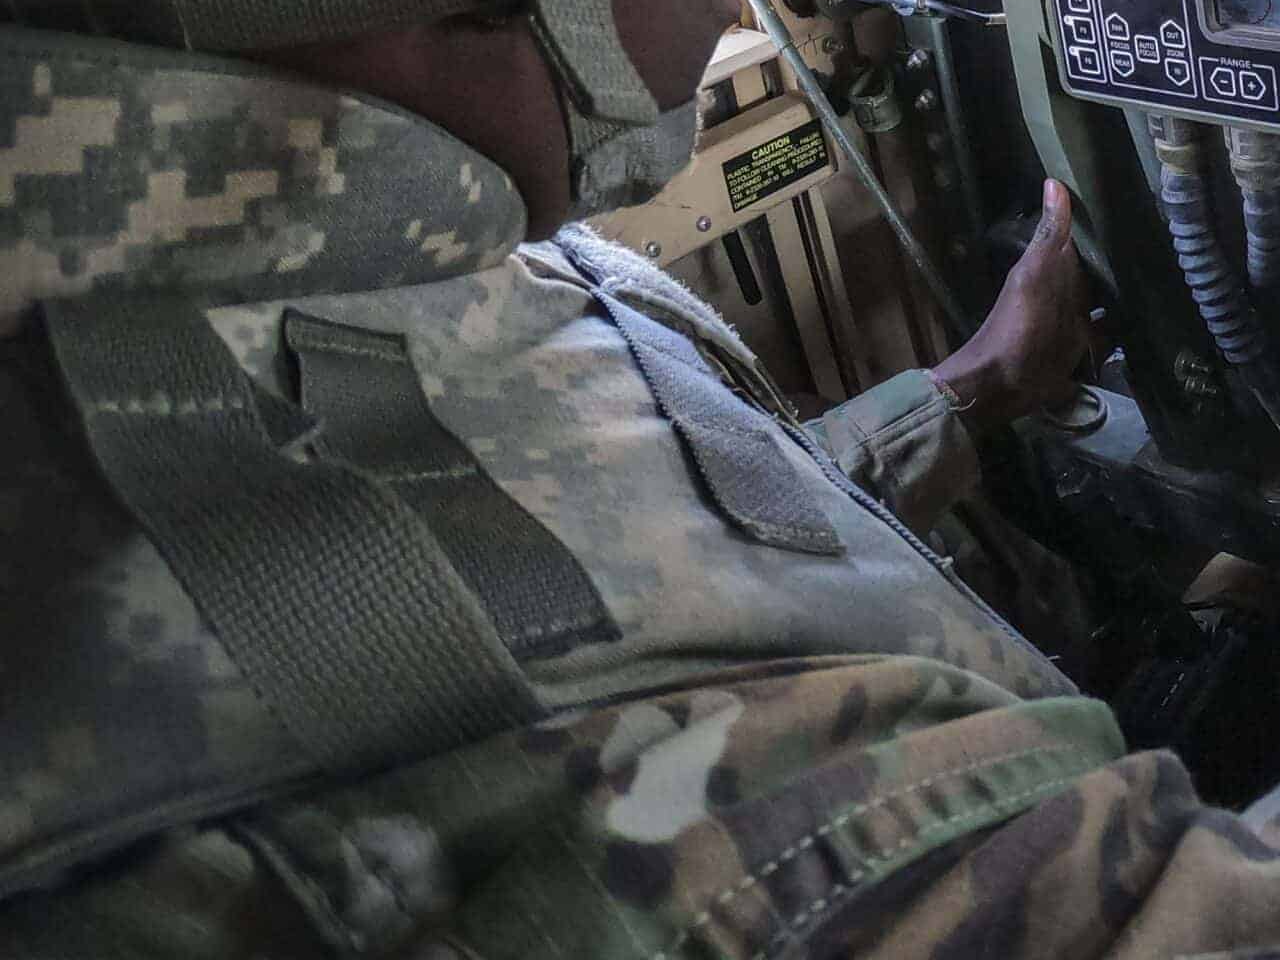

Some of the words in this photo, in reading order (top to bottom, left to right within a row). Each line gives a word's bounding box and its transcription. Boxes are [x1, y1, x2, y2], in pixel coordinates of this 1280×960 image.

[1166, 31, 1179, 39] OUT
[1110, 41, 1130, 50] FOCUS
[1220, 56, 1252, 69] RANGE
[752, 136, 790, 160] CAUTION
